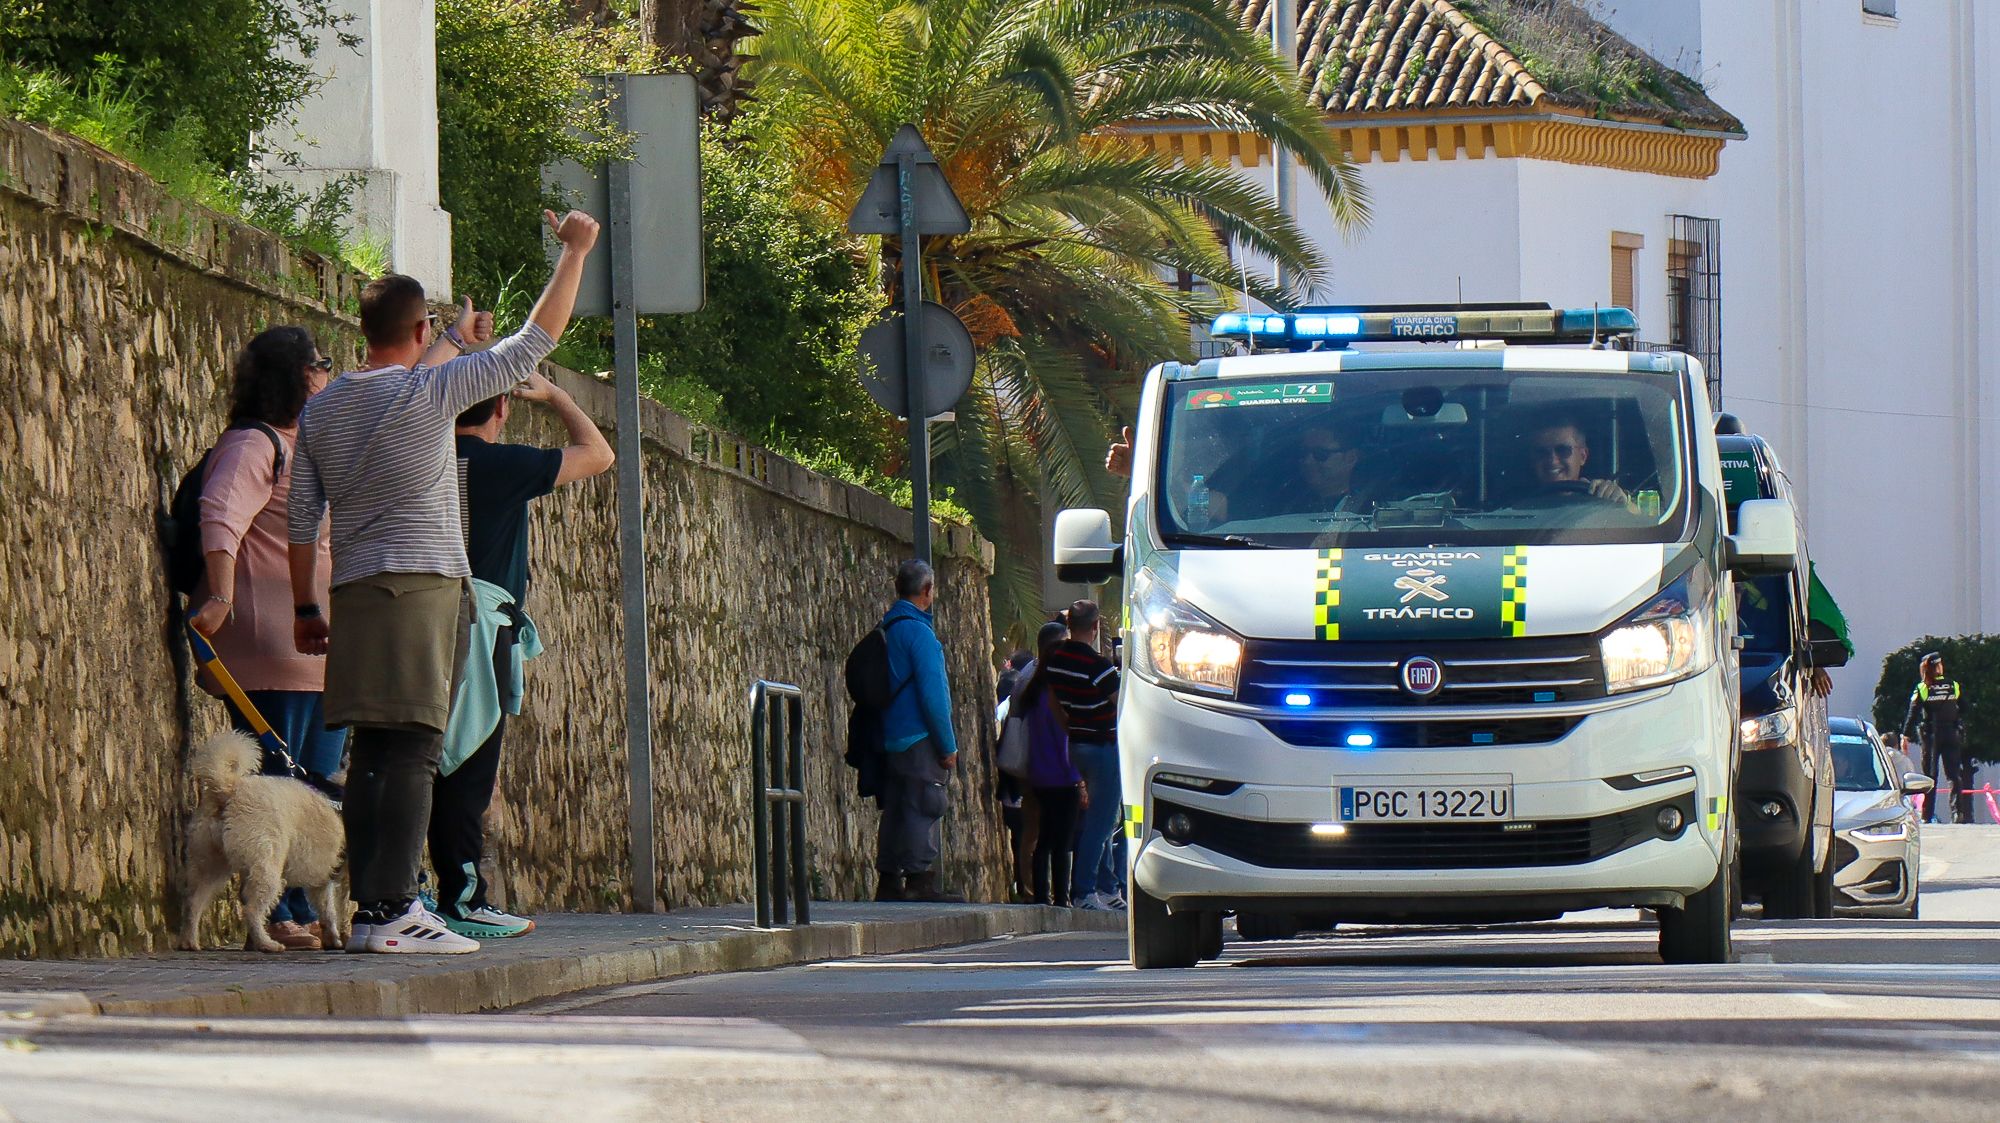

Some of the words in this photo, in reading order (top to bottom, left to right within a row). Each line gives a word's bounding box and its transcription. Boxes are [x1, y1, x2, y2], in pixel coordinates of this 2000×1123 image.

[1394, 317, 1432, 325] GUARDIA
[1394, 325, 1455, 336] TRAFICO
[1298, 385, 1317, 394] 74
[1238, 398, 1281, 406] GUARDIA
[1363, 552, 1481, 561] GUARDIA
[1362, 605, 1474, 619] TRÁFICO
[1410, 667, 1433, 685] FIAT
[1355, 790, 1408, 818] PGC
[1343, 808, 1350, 816] E
